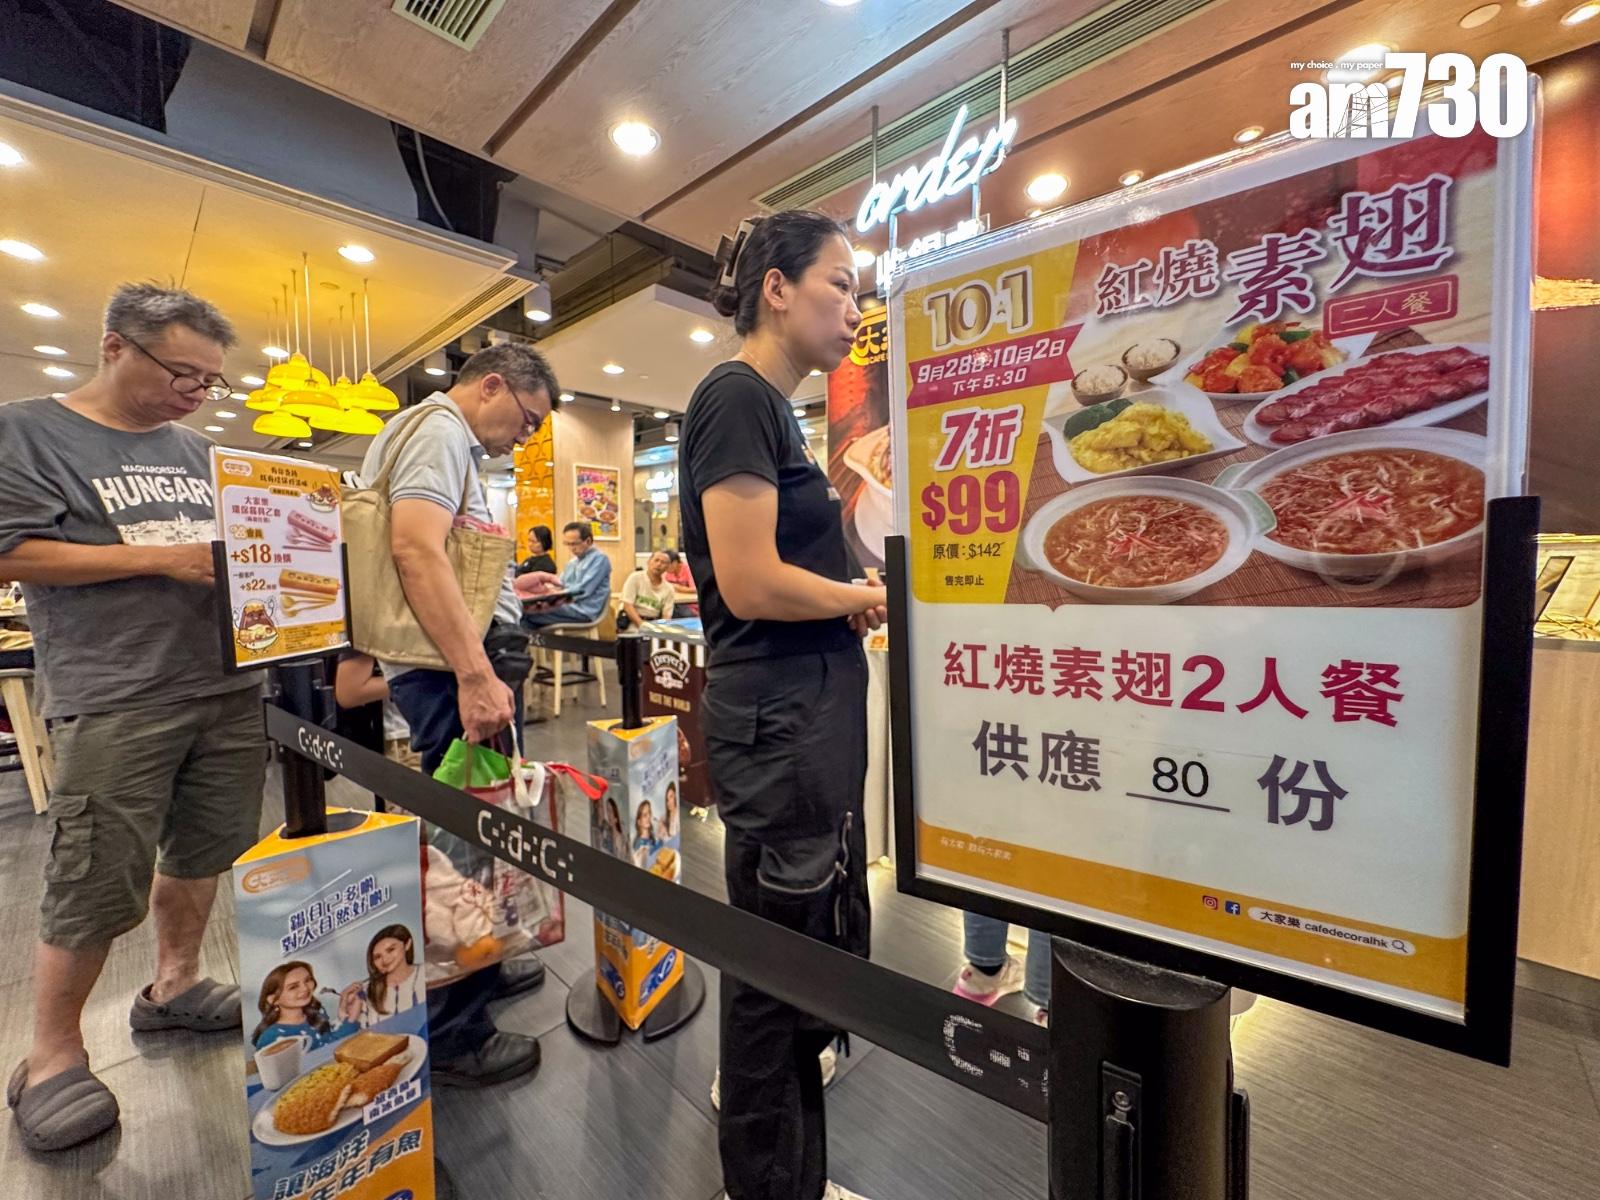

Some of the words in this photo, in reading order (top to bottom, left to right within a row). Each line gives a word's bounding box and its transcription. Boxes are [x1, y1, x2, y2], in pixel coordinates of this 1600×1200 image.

[857, 104, 1017, 233] order
[1096, 174, 1453, 325] 紅燒素翅
[1340, 290, 1433, 326] 二人餐
[937, 406, 1021, 469] 7折
[921, 470, 1020, 535] $99
[945, 575, 984, 586] 售完即止
[943, 641, 1405, 728] 紅燒素翅2人餐
[972, 720, 1102, 792] 供應
[1151, 756, 1209, 798] 80
[1257, 754, 1349, 831] 份
[1260, 911, 1300, 928] 大家樂
[1305, 921, 1388, 949] cafedecoralhk
